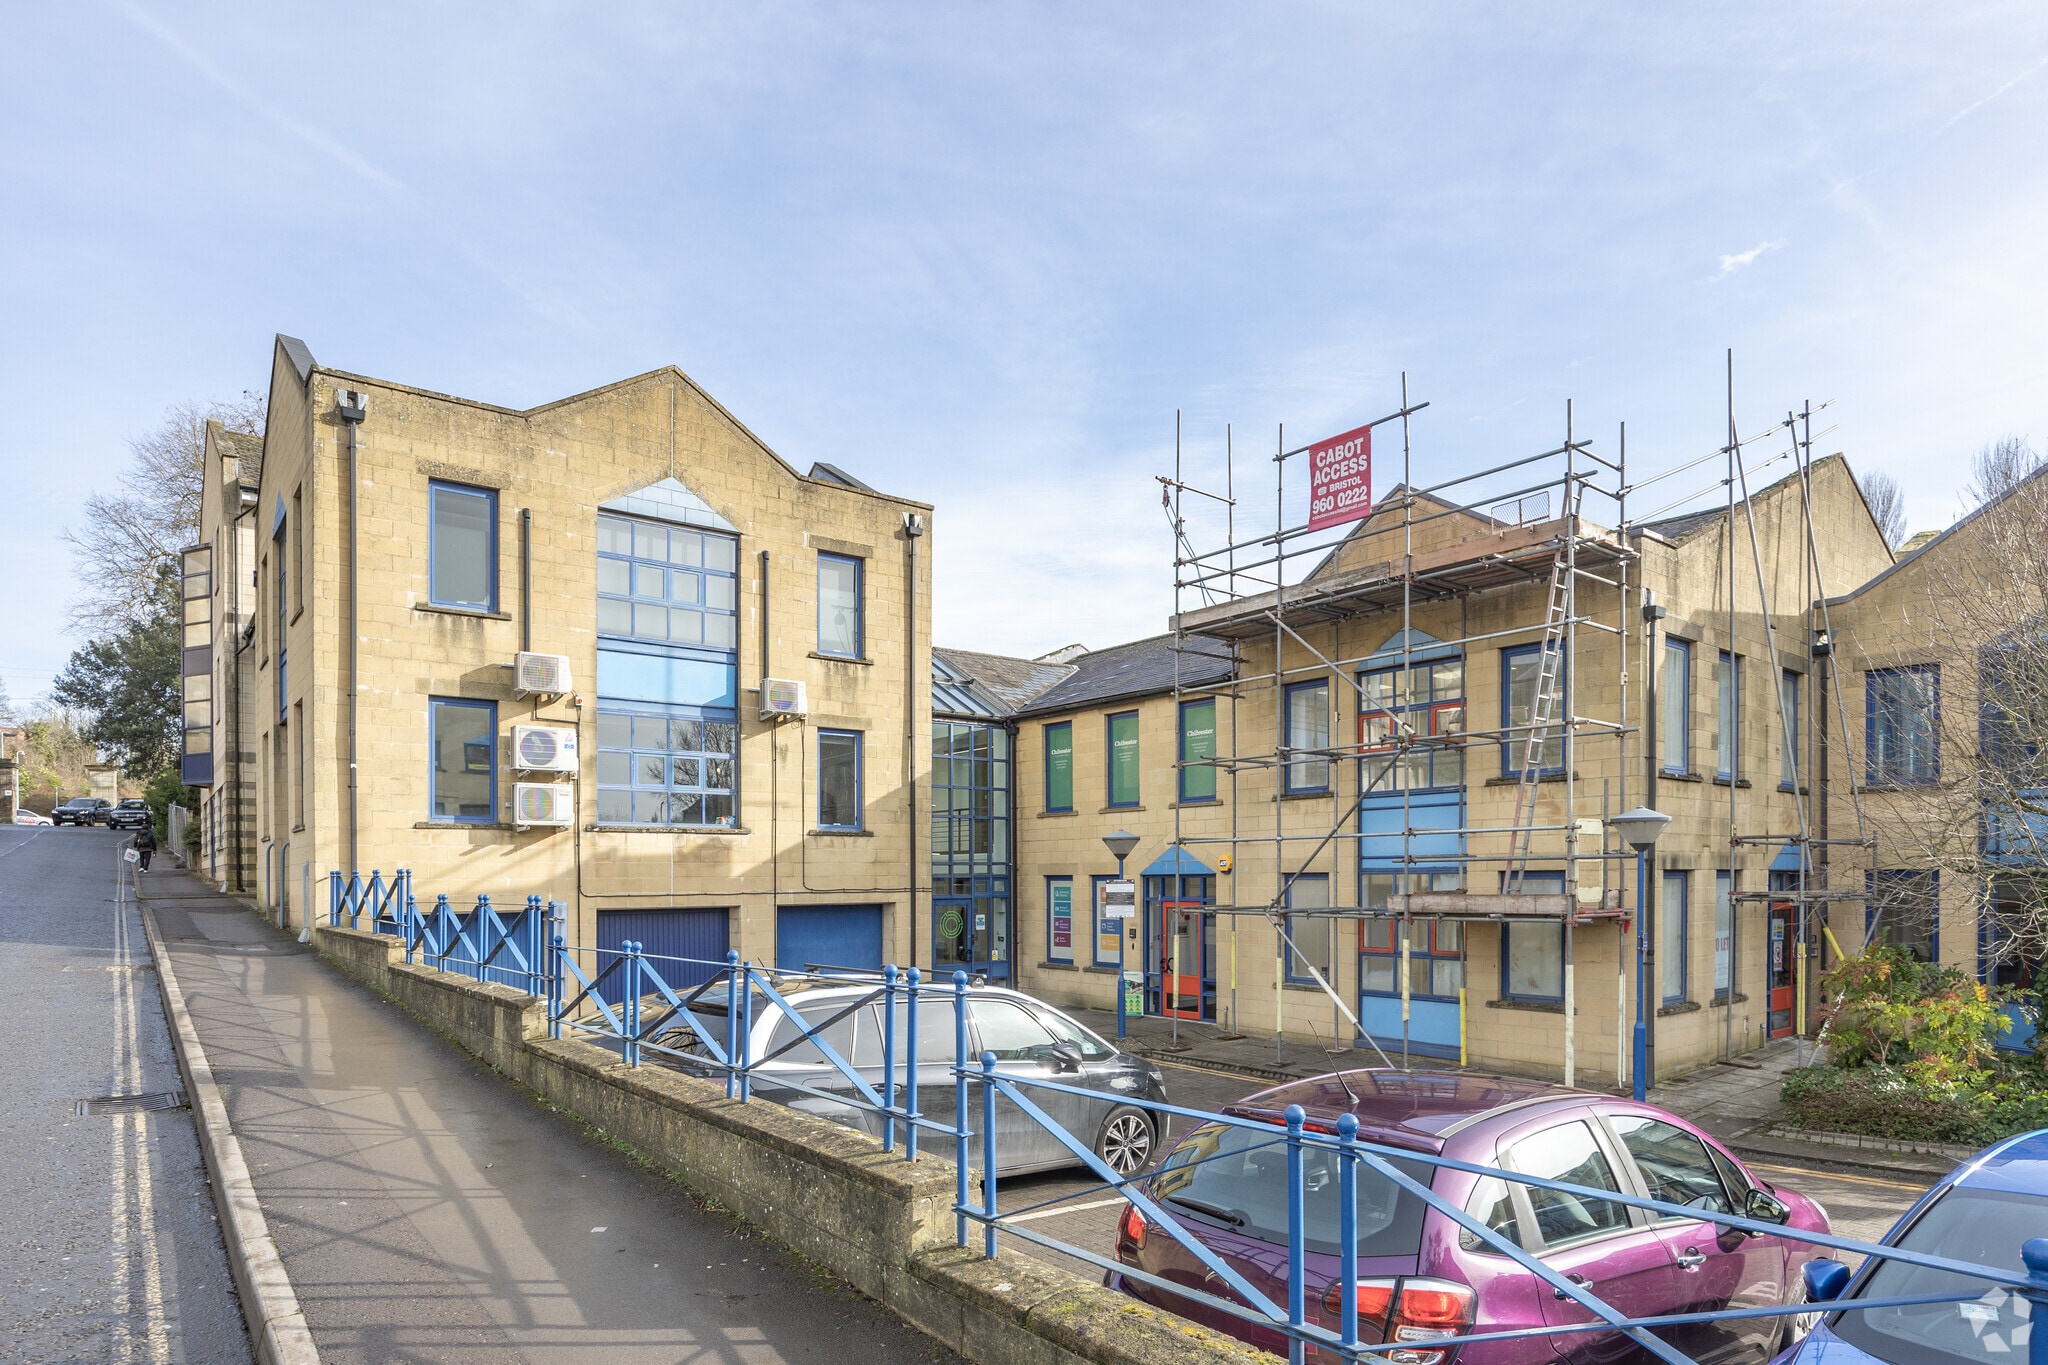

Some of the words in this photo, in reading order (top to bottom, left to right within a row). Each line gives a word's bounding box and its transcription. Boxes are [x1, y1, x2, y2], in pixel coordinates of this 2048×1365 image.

[1316, 437, 1364, 468] CABOT
[1313, 454, 1368, 487] ACCESS
[1329, 475, 1363, 493] BRISTOL
[1312, 495, 1335, 515] 960
[1337, 485, 1368, 508] 0222
